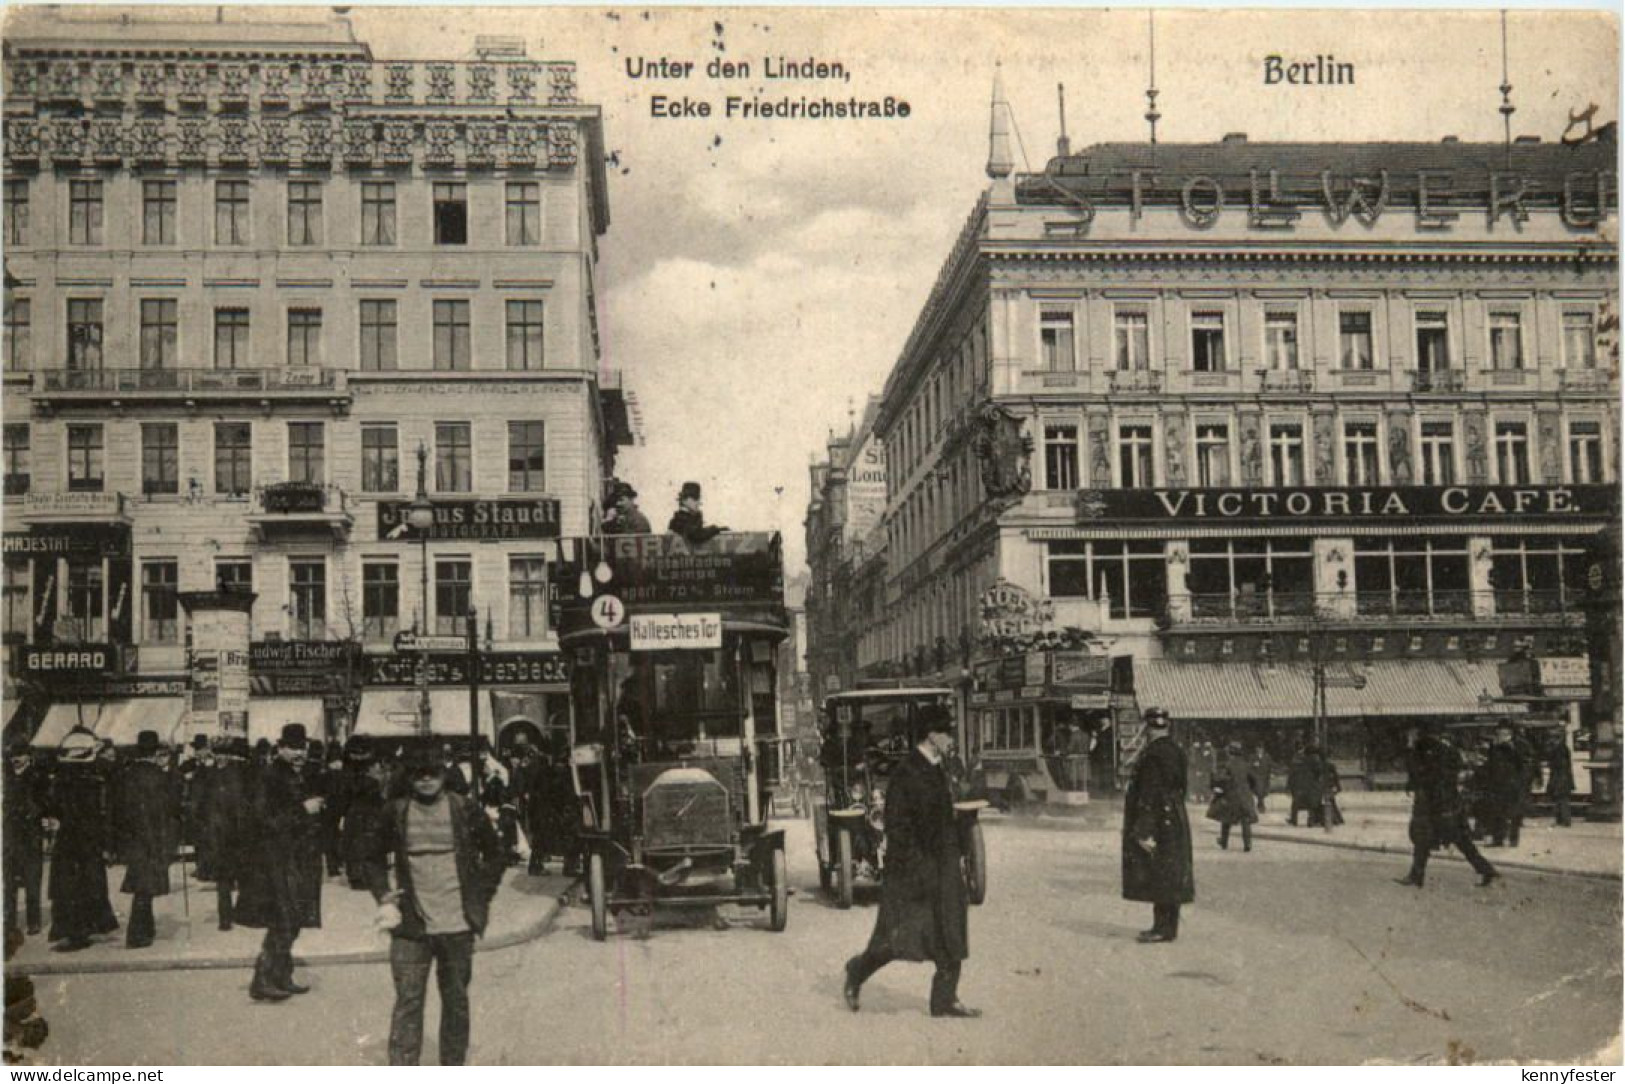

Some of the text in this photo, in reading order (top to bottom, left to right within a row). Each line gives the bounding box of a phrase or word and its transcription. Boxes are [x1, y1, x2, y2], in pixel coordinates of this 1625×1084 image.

[473, 501, 557, 524] Staudt
[1154, 491, 1410, 517] VICTORIA
[600, 602, 617, 622] 4
[700, 617, 718, 638] Tor
